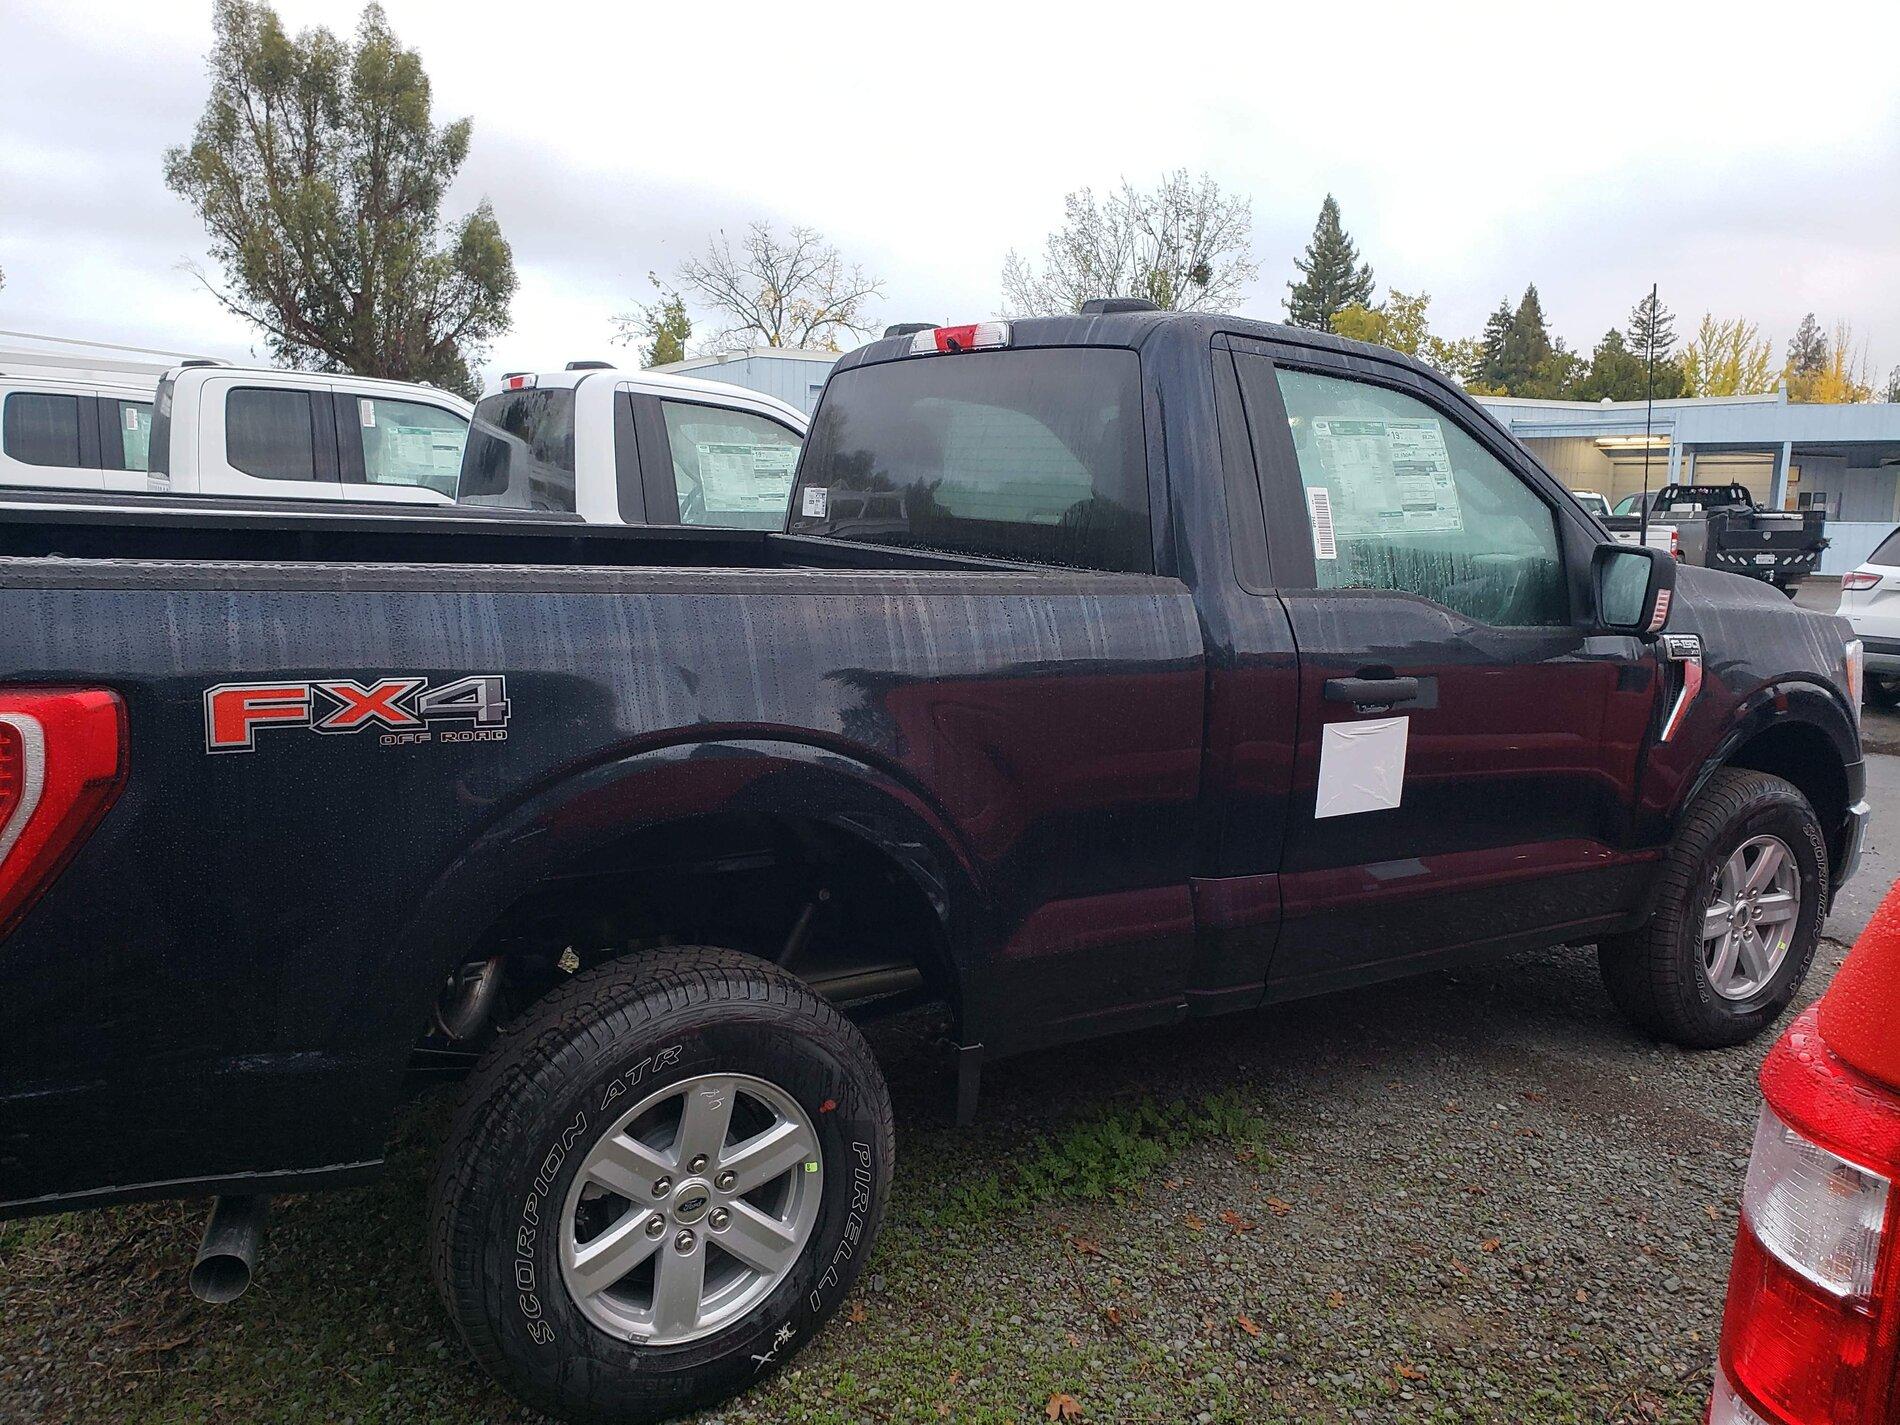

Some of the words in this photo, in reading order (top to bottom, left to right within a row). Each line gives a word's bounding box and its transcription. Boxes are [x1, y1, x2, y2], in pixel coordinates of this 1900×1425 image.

[203, 675, 511, 754] FX4
[379, 732, 432, 746] OFF
[440, 729, 508, 744] ROAD
[1803, 822, 1827, 940] SCORPION
[515, 1111, 588, 1345] SCORPION
[600, 1045, 683, 1111] ATR
[810, 1141, 872, 1313] PIRELLI
